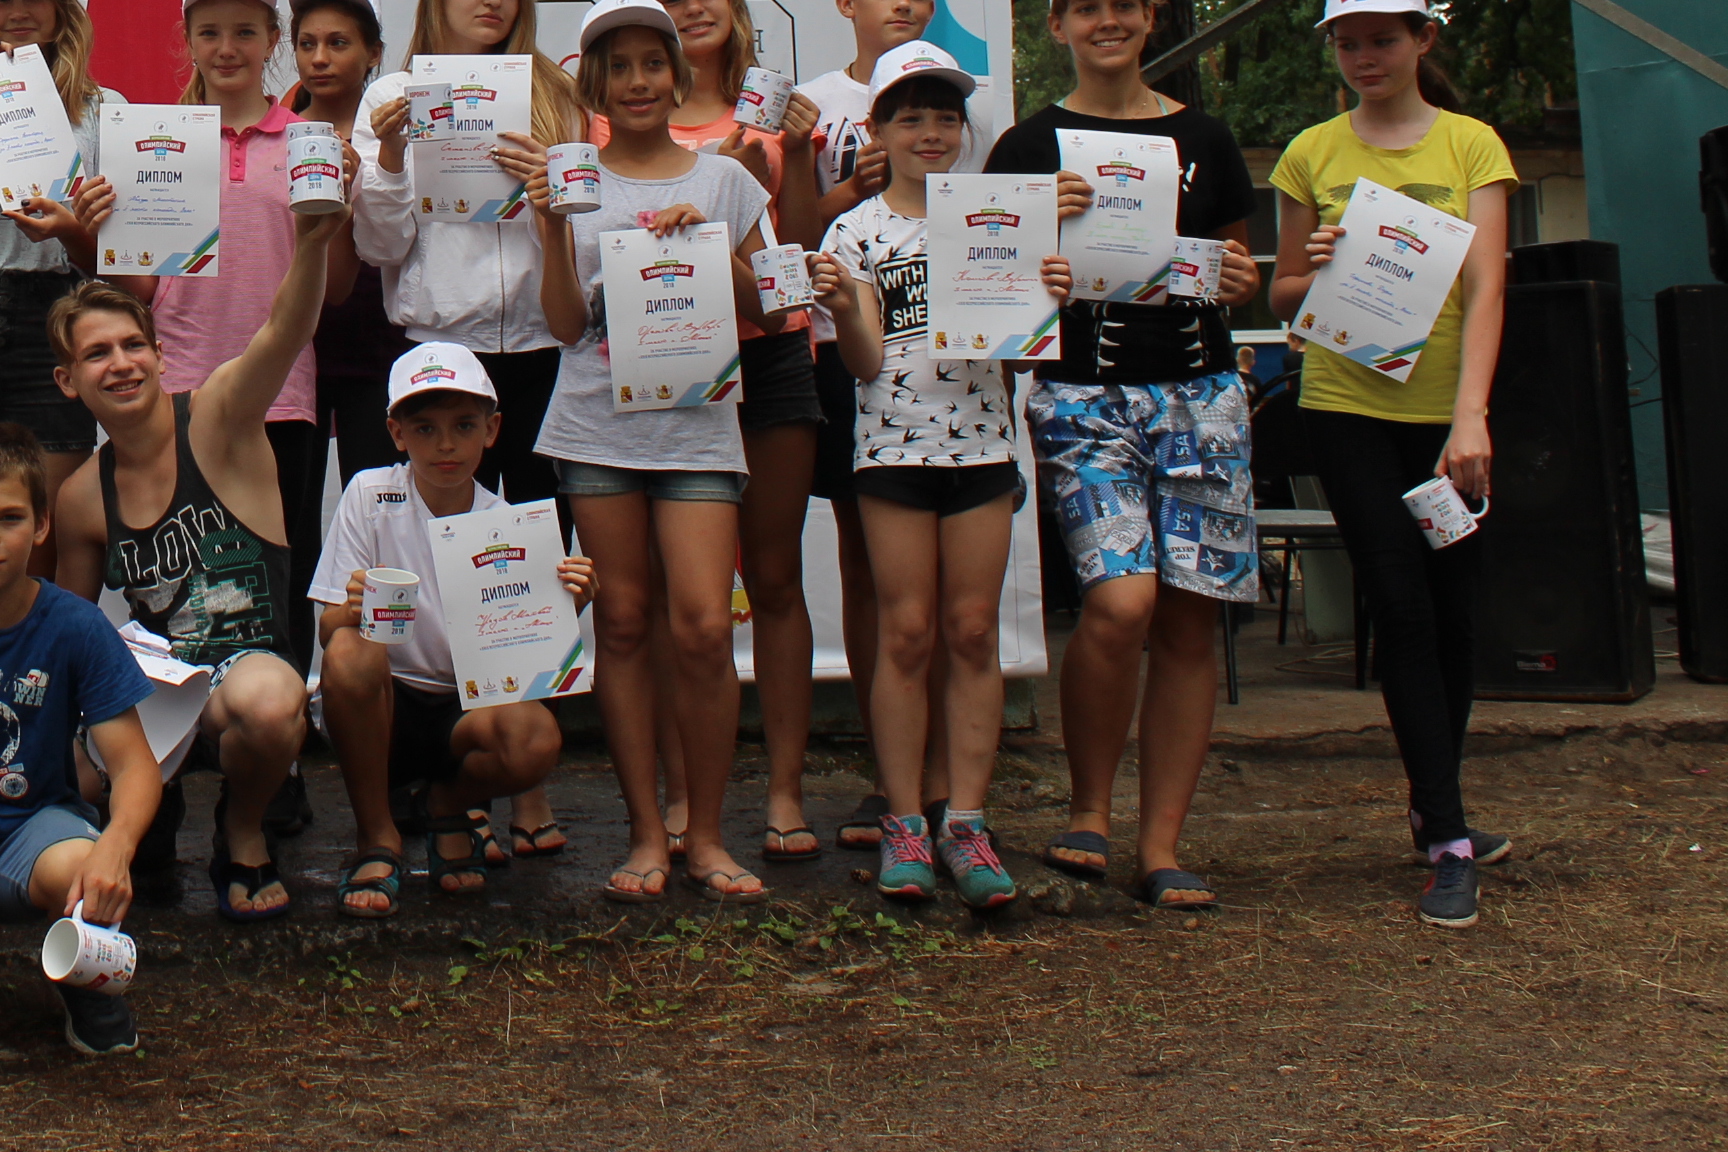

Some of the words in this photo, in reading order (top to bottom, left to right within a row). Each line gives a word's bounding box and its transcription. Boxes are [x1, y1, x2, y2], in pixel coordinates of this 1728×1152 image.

[136, 170, 182, 184] ДИПЛОМ
[1097, 195, 1142, 211] ДИПЛОМ
[967, 247, 1017, 262] ДИПЛОМ
[1365, 253, 1414, 282] ДИПЛОМ
[645, 297, 695, 315] ДИПЛОМ
[481, 581, 531, 604] ДИПЛОМ
[391, 627, 404, 635] 2018
